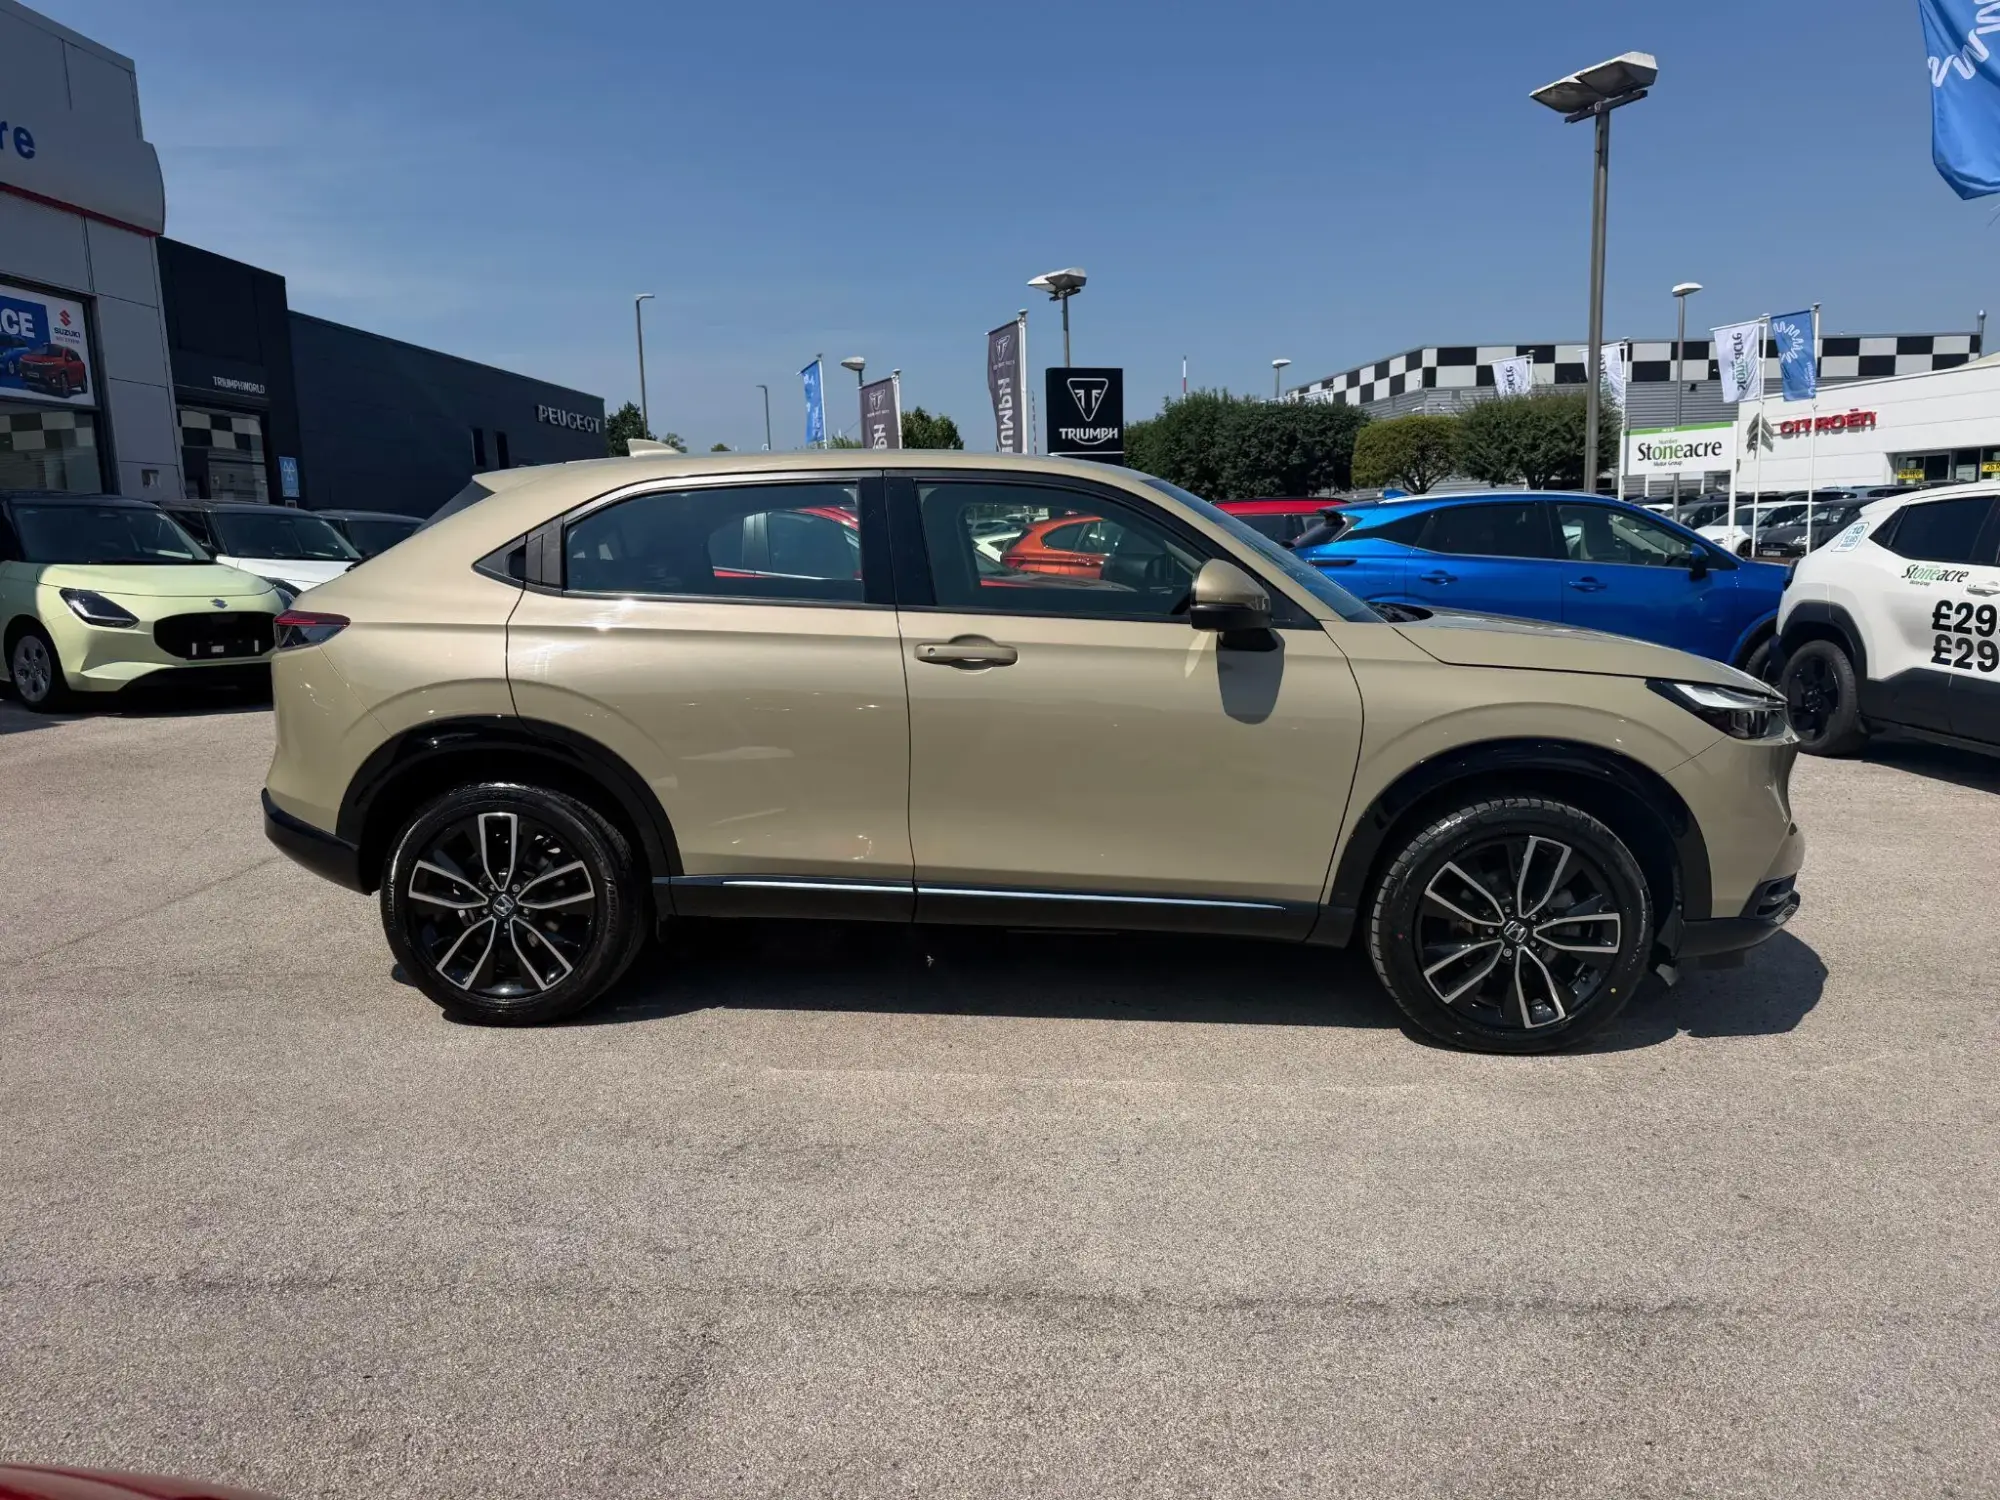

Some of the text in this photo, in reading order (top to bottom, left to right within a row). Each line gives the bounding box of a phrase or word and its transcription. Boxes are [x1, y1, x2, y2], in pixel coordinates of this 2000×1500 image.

[0, 308, 35, 338] CE
[538, 404, 600, 433] PEUGEOT
[1059, 427, 1118, 442] TRIUMPH
[1638, 441, 1722, 461] Stoneacre
[1901, 564, 1970, 583] Stoneacre
[1932, 600, 2000, 637] £29
